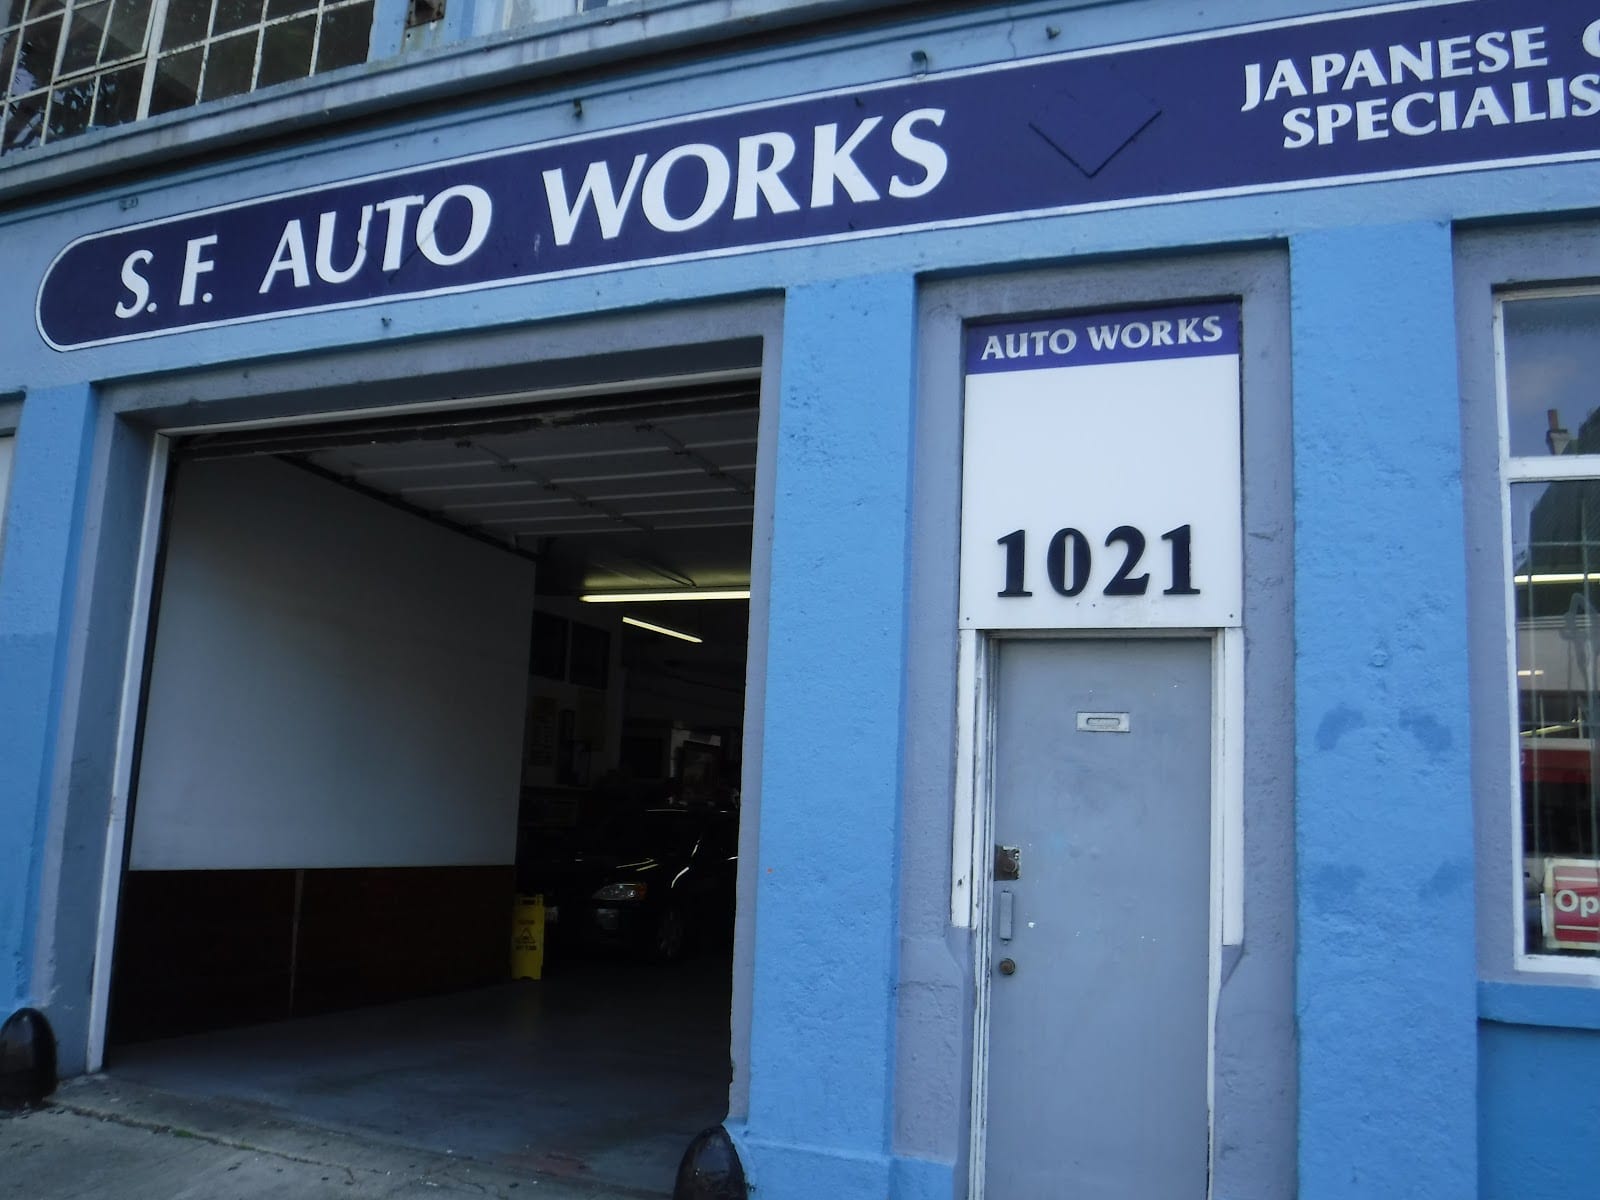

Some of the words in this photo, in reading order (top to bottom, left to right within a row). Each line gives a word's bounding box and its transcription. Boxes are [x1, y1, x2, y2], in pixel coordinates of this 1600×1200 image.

[1241, 26, 1548, 112] JAPANESE
[1283, 74, 1600, 149] SPECIALIS
[115, 249, 157, 319] S.
[178, 234, 218, 306] F.
[259, 184, 493, 294] AUTO
[542, 108, 948, 246] WORKS
[981, 328, 1077, 360] AUTO
[1087, 315, 1223, 351] WORKS
[997, 524, 1201, 598] 1021
[1555, 889, 1600, 918] Op
